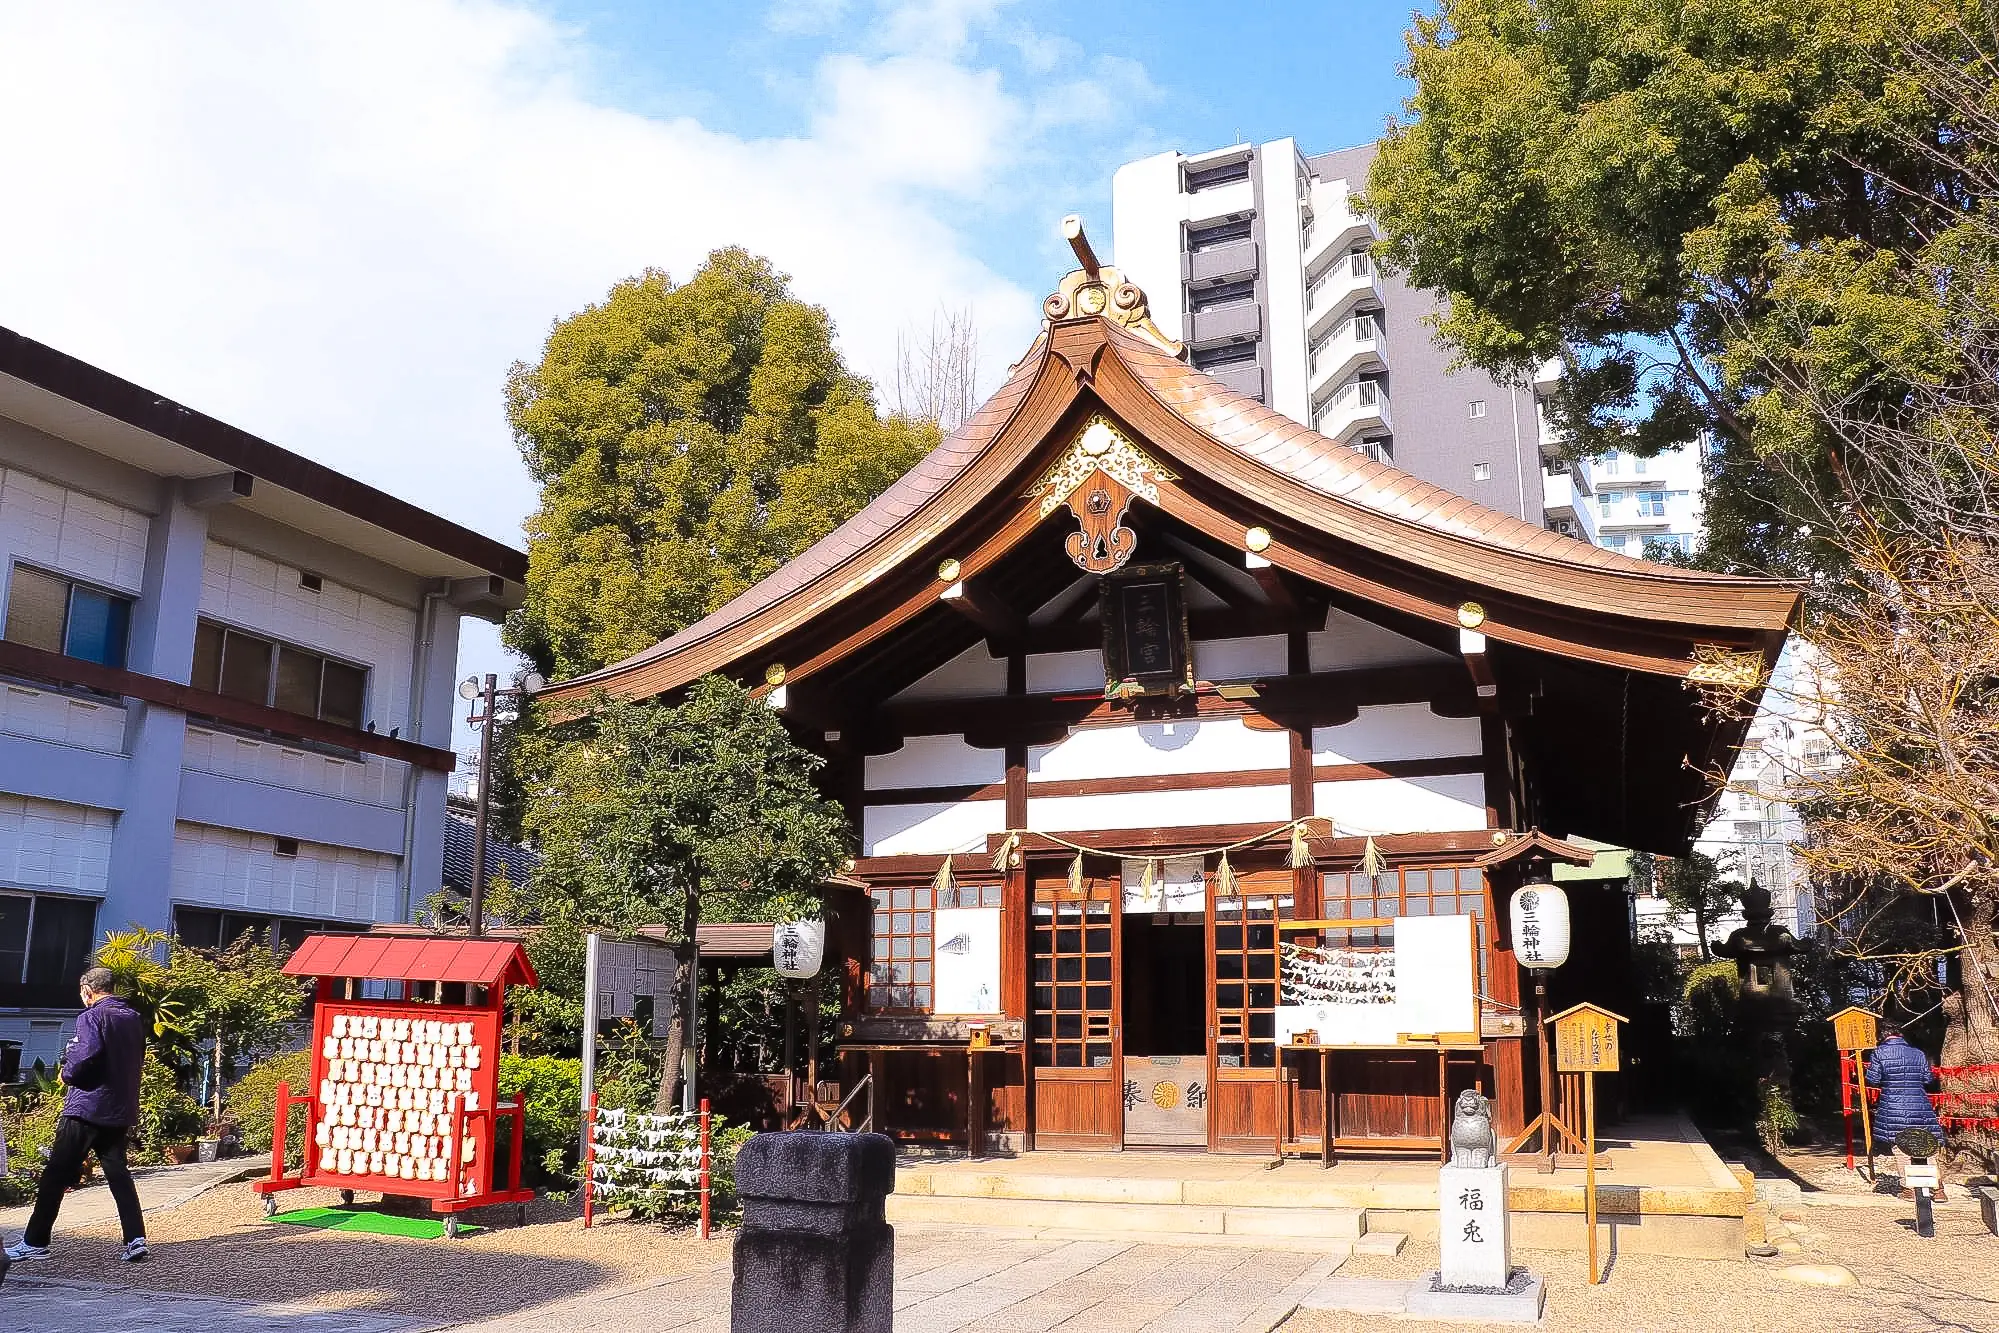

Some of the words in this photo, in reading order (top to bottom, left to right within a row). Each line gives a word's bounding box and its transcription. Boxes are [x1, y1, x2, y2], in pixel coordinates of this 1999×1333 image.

[782, 927, 800, 971] 三輪神社
[1522, 912, 1544, 962] 三輪神社
[1602, 1021, 1613, 1051] 幸せの
